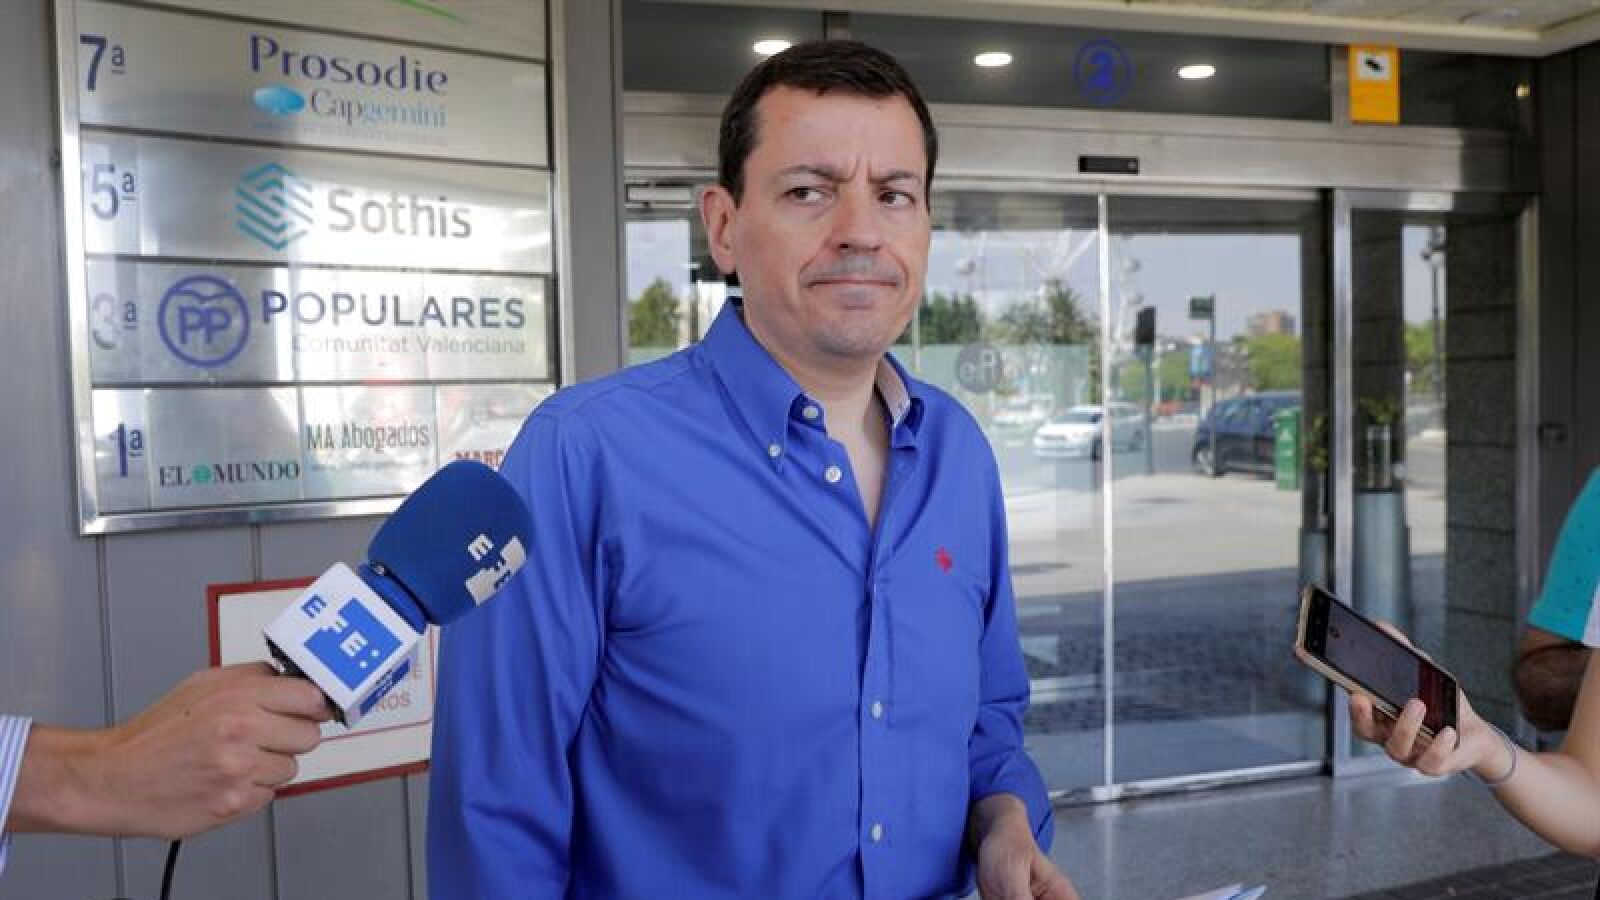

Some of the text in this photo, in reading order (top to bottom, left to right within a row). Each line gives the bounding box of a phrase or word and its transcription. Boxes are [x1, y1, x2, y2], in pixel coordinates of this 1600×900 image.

[250, 33, 449, 96] Prosodie
[310, 87, 447, 128] Capgemini
[328, 189, 472, 239] Sothis
[177, 305, 232, 345] PP
[262, 290, 526, 329] POPULARES
[292, 334, 526, 354] Comunitat Valenciana
[307, 420, 431, 453] MA Abogados
[212, 461, 299, 485] MUNDO
